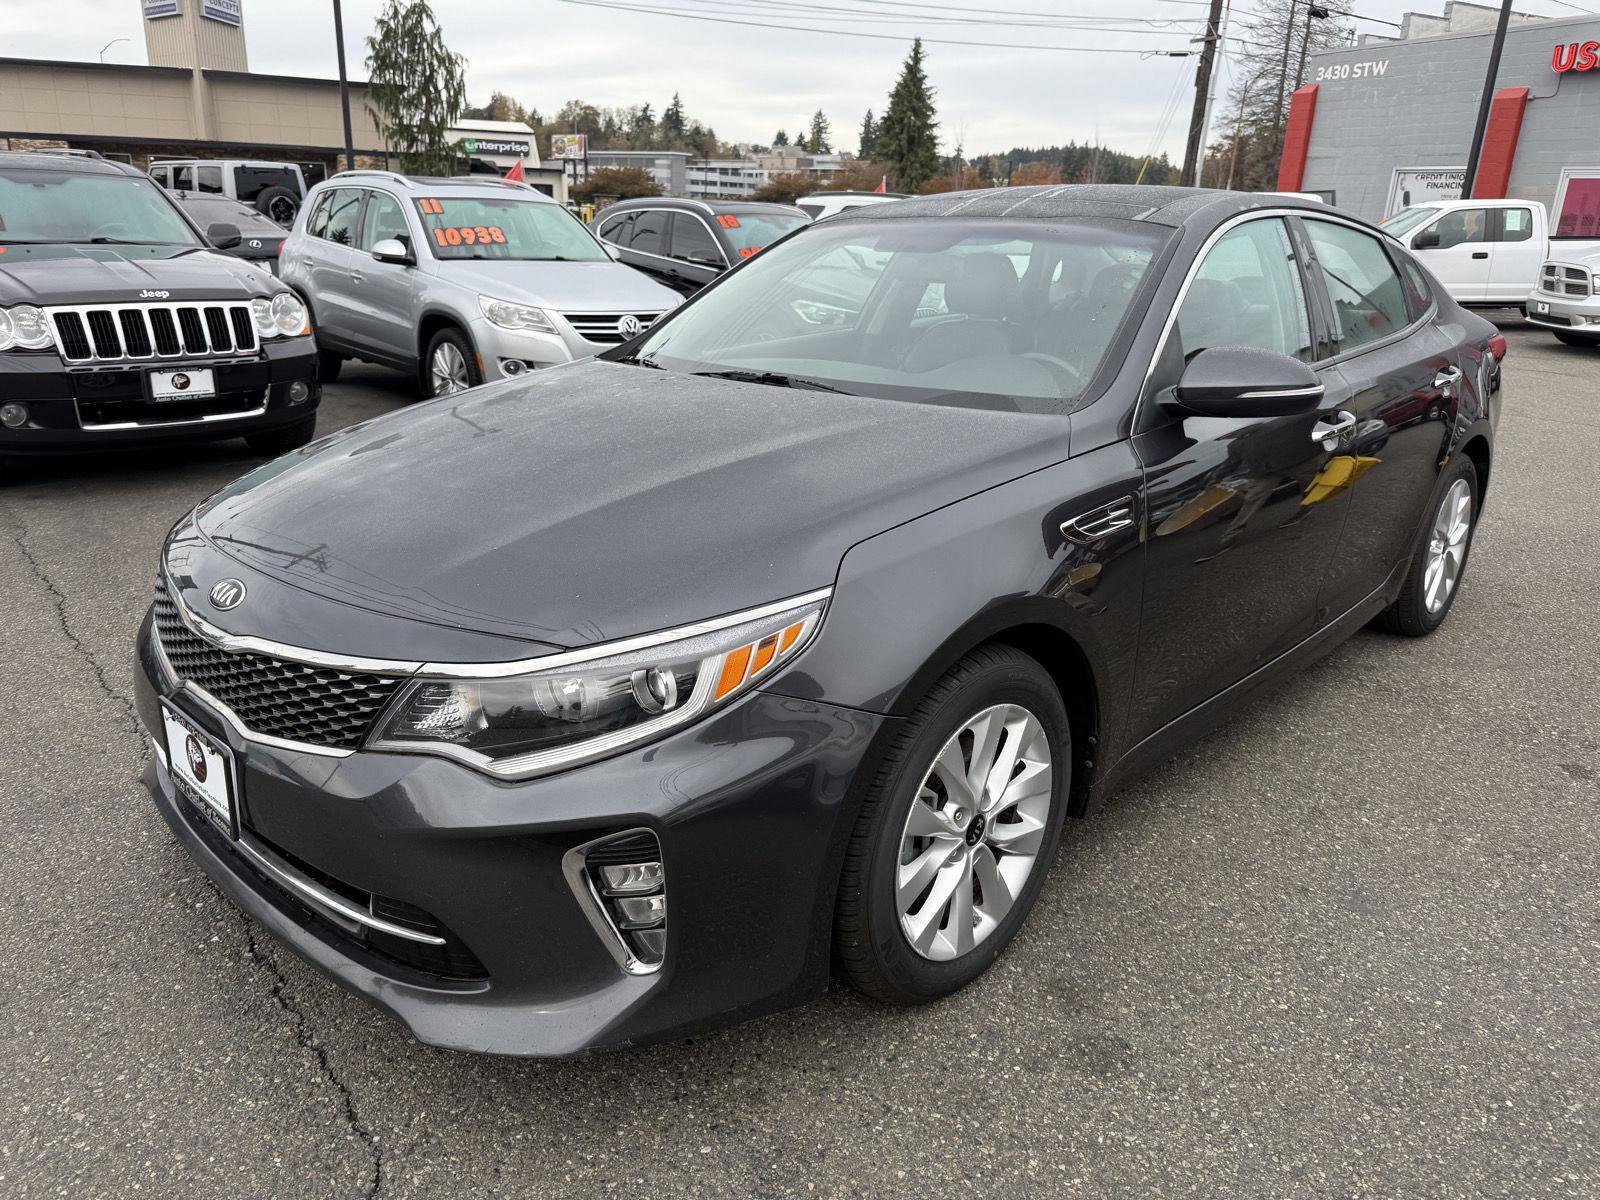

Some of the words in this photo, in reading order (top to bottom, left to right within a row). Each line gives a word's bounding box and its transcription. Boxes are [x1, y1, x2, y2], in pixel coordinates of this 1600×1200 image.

[1552, 41, 1600, 73] US
[1316, 64, 1350, 80] 3430
[1352, 60, 1389, 78] STW
[464, 140, 529, 152] enterprise
[1416, 173, 1443, 181] CREDIT
[1445, 173, 1466, 181] UNIO
[1426, 181, 1464, 189] FINANCIN
[417, 198, 445, 214] 11
[433, 226, 508, 247] 10938
[139, 289, 170, 298] Jeep
